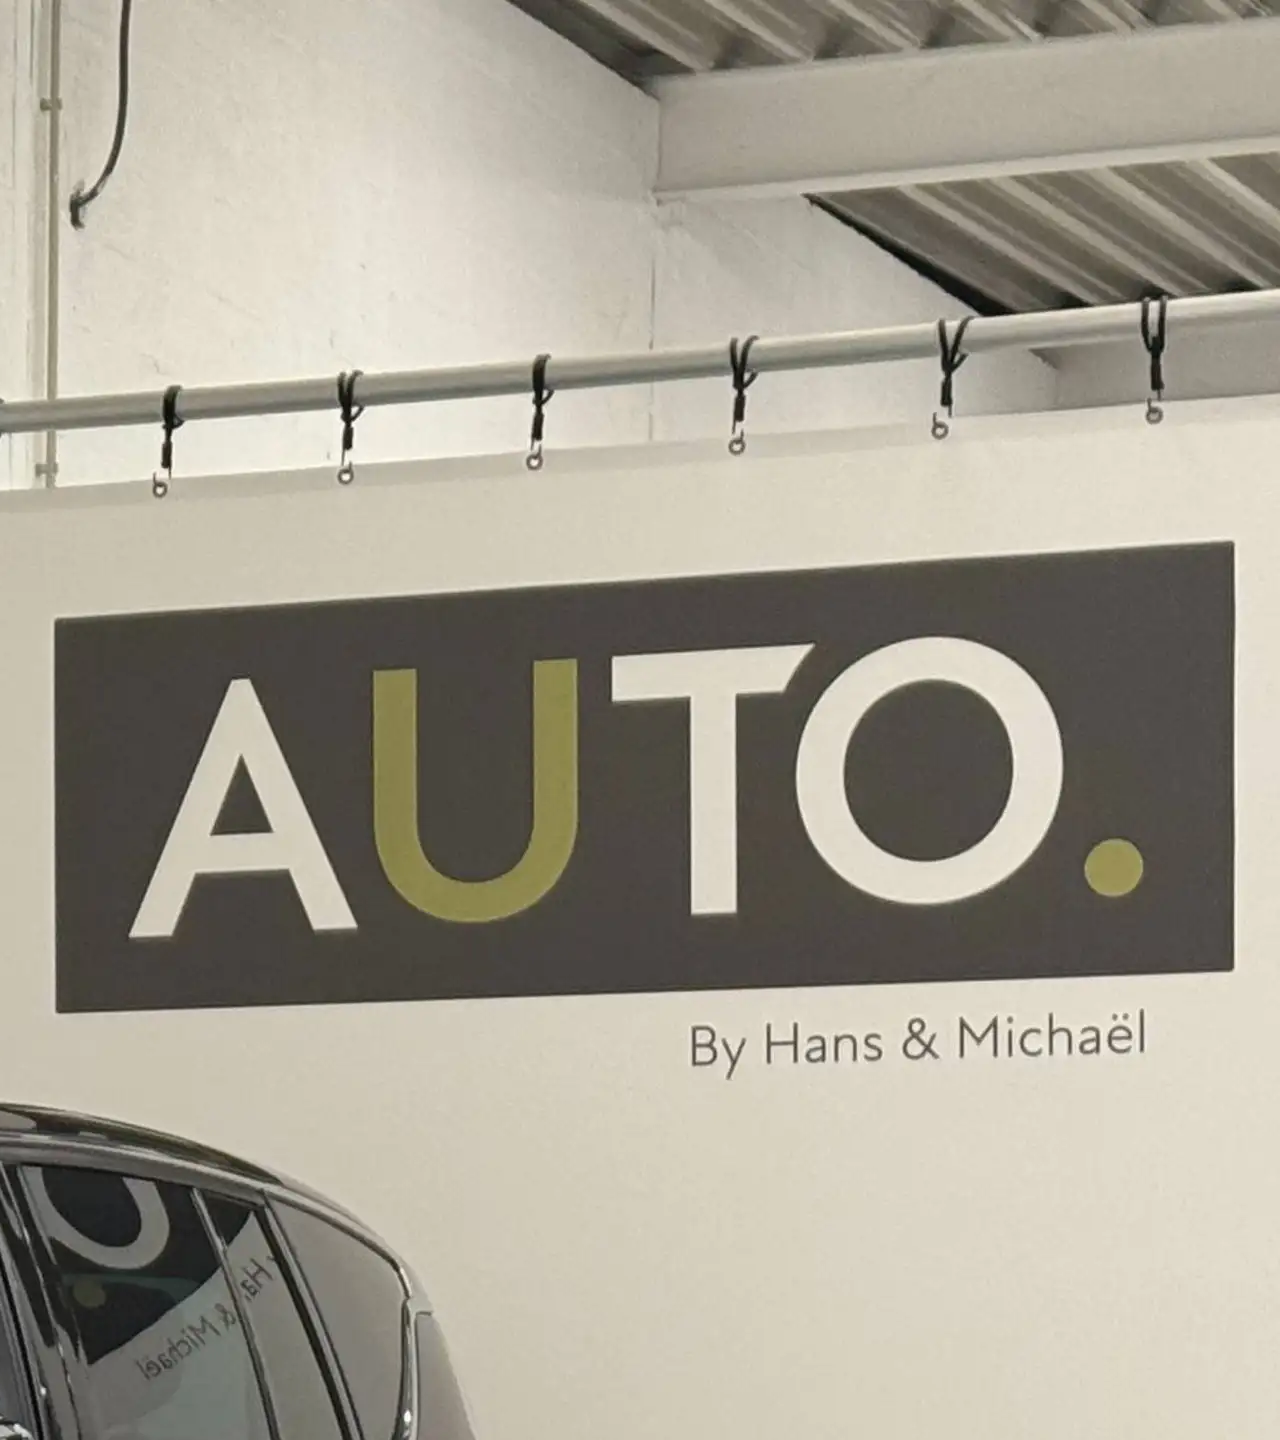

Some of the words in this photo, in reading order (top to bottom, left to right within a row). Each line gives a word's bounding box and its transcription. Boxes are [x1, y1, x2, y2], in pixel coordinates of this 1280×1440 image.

[128, 636, 1144, 939] AUTO.
[691, 1024, 747, 1080] By
[765, 1021, 884, 1065] Hans
[902, 1017, 940, 1061] &
[959, 1008, 1146, 1059] Michaël
